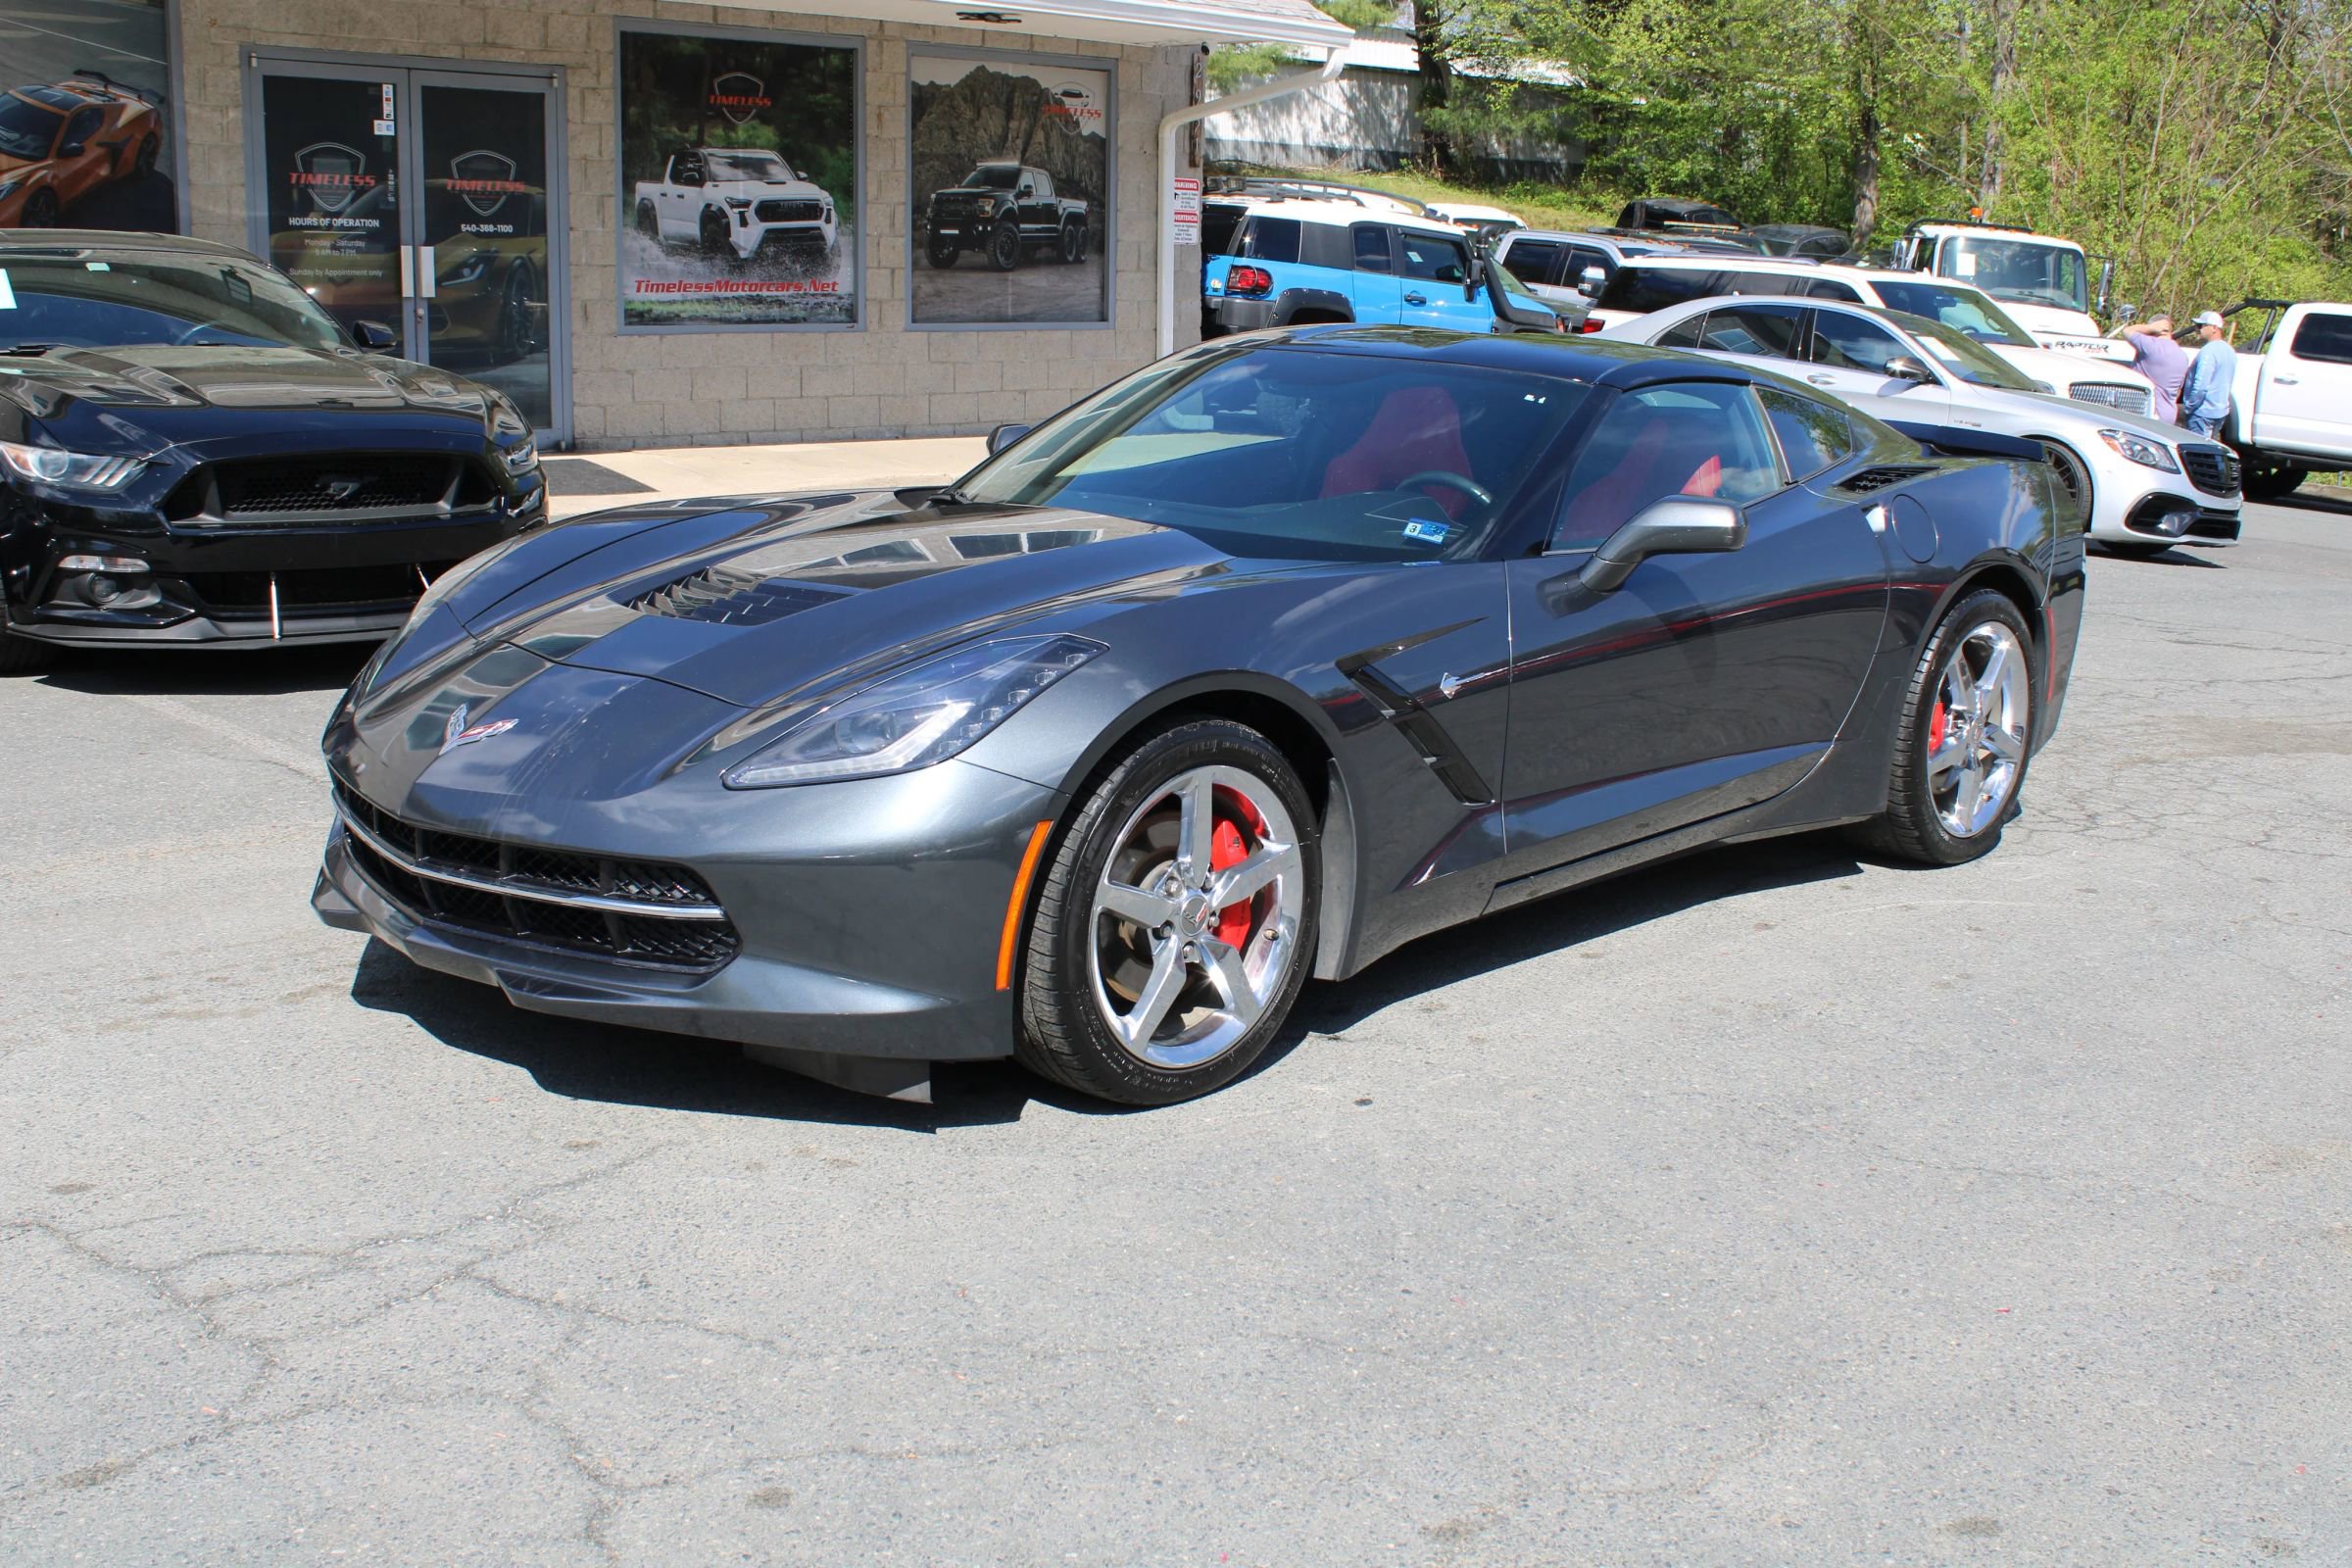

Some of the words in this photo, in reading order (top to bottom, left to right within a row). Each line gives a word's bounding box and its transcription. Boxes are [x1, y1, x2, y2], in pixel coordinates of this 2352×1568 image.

[709, 94, 772, 107] TIMELESS
[289, 172, 376, 186] TIMELESS
[446, 178, 525, 192] TIMELESS
[288, 218, 318, 226] HOURS
[319, 218, 331, 226] OF
[332, 219, 380, 227] OPERATION
[304, 239, 330, 248] Monday
[336, 239, 367, 248] Saturday
[635, 278, 839, 293] TimelessMotorcars.Net
[2055, 340, 2109, 353] RAPTOR
